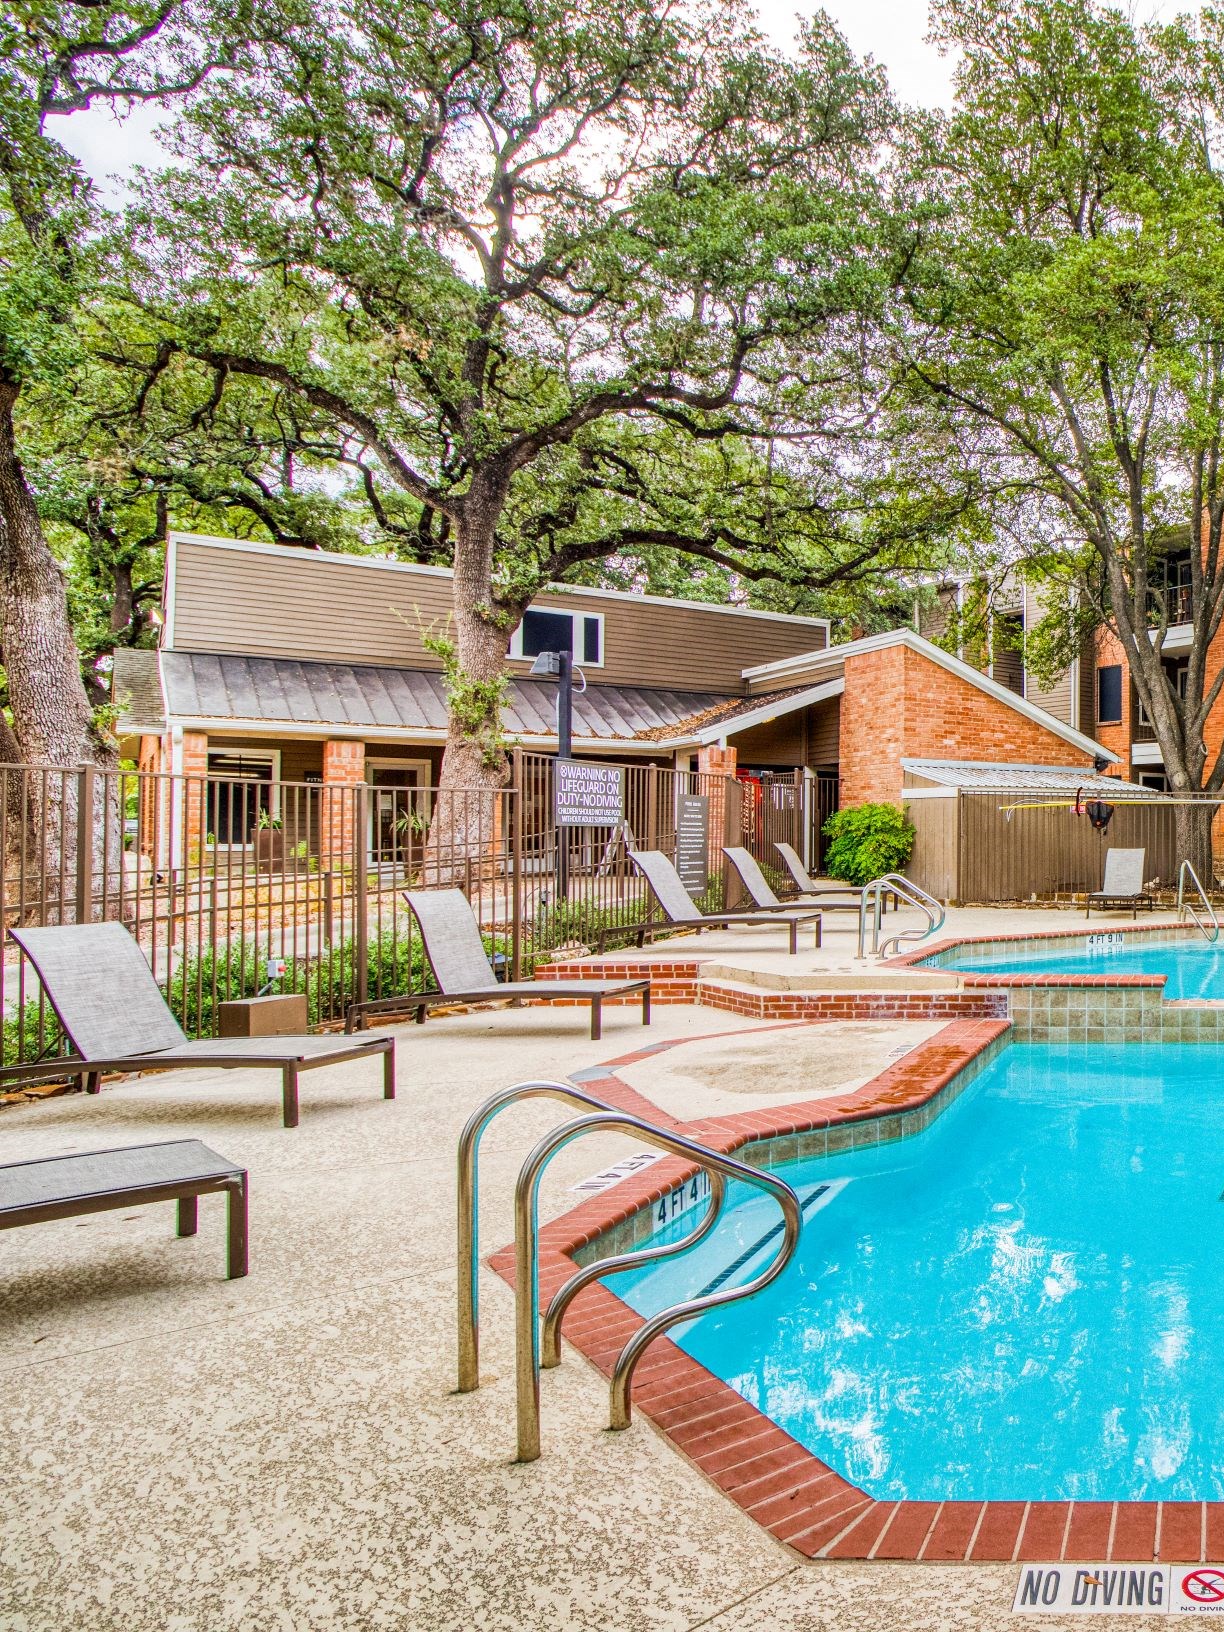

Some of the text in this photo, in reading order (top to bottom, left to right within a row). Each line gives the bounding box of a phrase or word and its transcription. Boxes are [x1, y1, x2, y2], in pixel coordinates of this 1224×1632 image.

[567, 766, 620, 782] WARNING NO
[562, 779, 619, 795] LIFEGUARD ON
[596, 795, 623, 807] DIVING
[558, 807, 579, 815] CHILDREN
[579, 808, 595, 816] SHOULD
[595, 808, 603, 816] NOT
[561, 815, 581, 823] WITHOUT
[1089, 933, 1123, 944] 4 FT 9 IN
[612, 1161, 645, 1170] FT
[574, 1181, 611, 1190] IN
[658, 1198, 667, 1223] 4
[671, 1185, 685, 1217] FT
[690, 1177, 698, 1201] 4
[1020, 1569, 1164, 1607] NO DIVING
